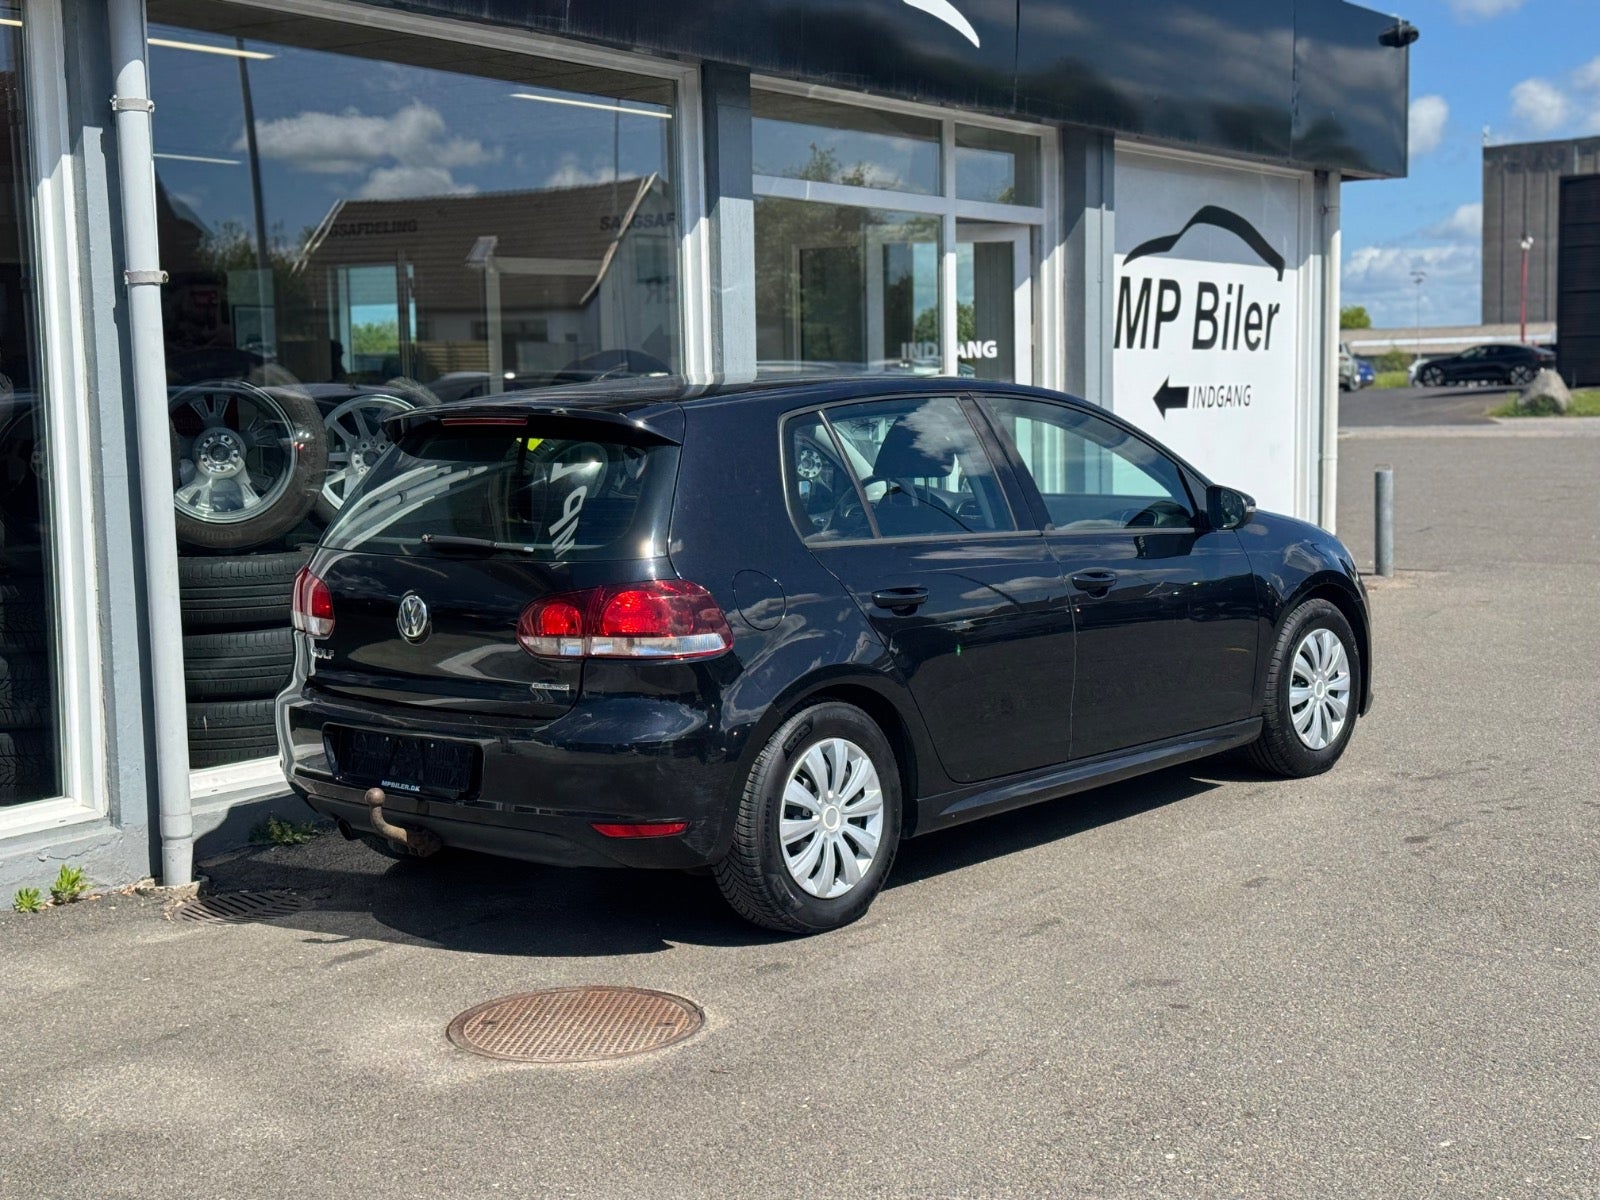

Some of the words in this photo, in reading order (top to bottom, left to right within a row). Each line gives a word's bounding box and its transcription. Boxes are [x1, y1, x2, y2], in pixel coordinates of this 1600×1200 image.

[1114, 276, 1181, 349] MP
[1192, 281, 1280, 351] Biler
[901, 340, 998, 359] INDANG
[1193, 385, 1251, 408] INDGANG
[381, 780, 421, 792] MPBILER.DK
